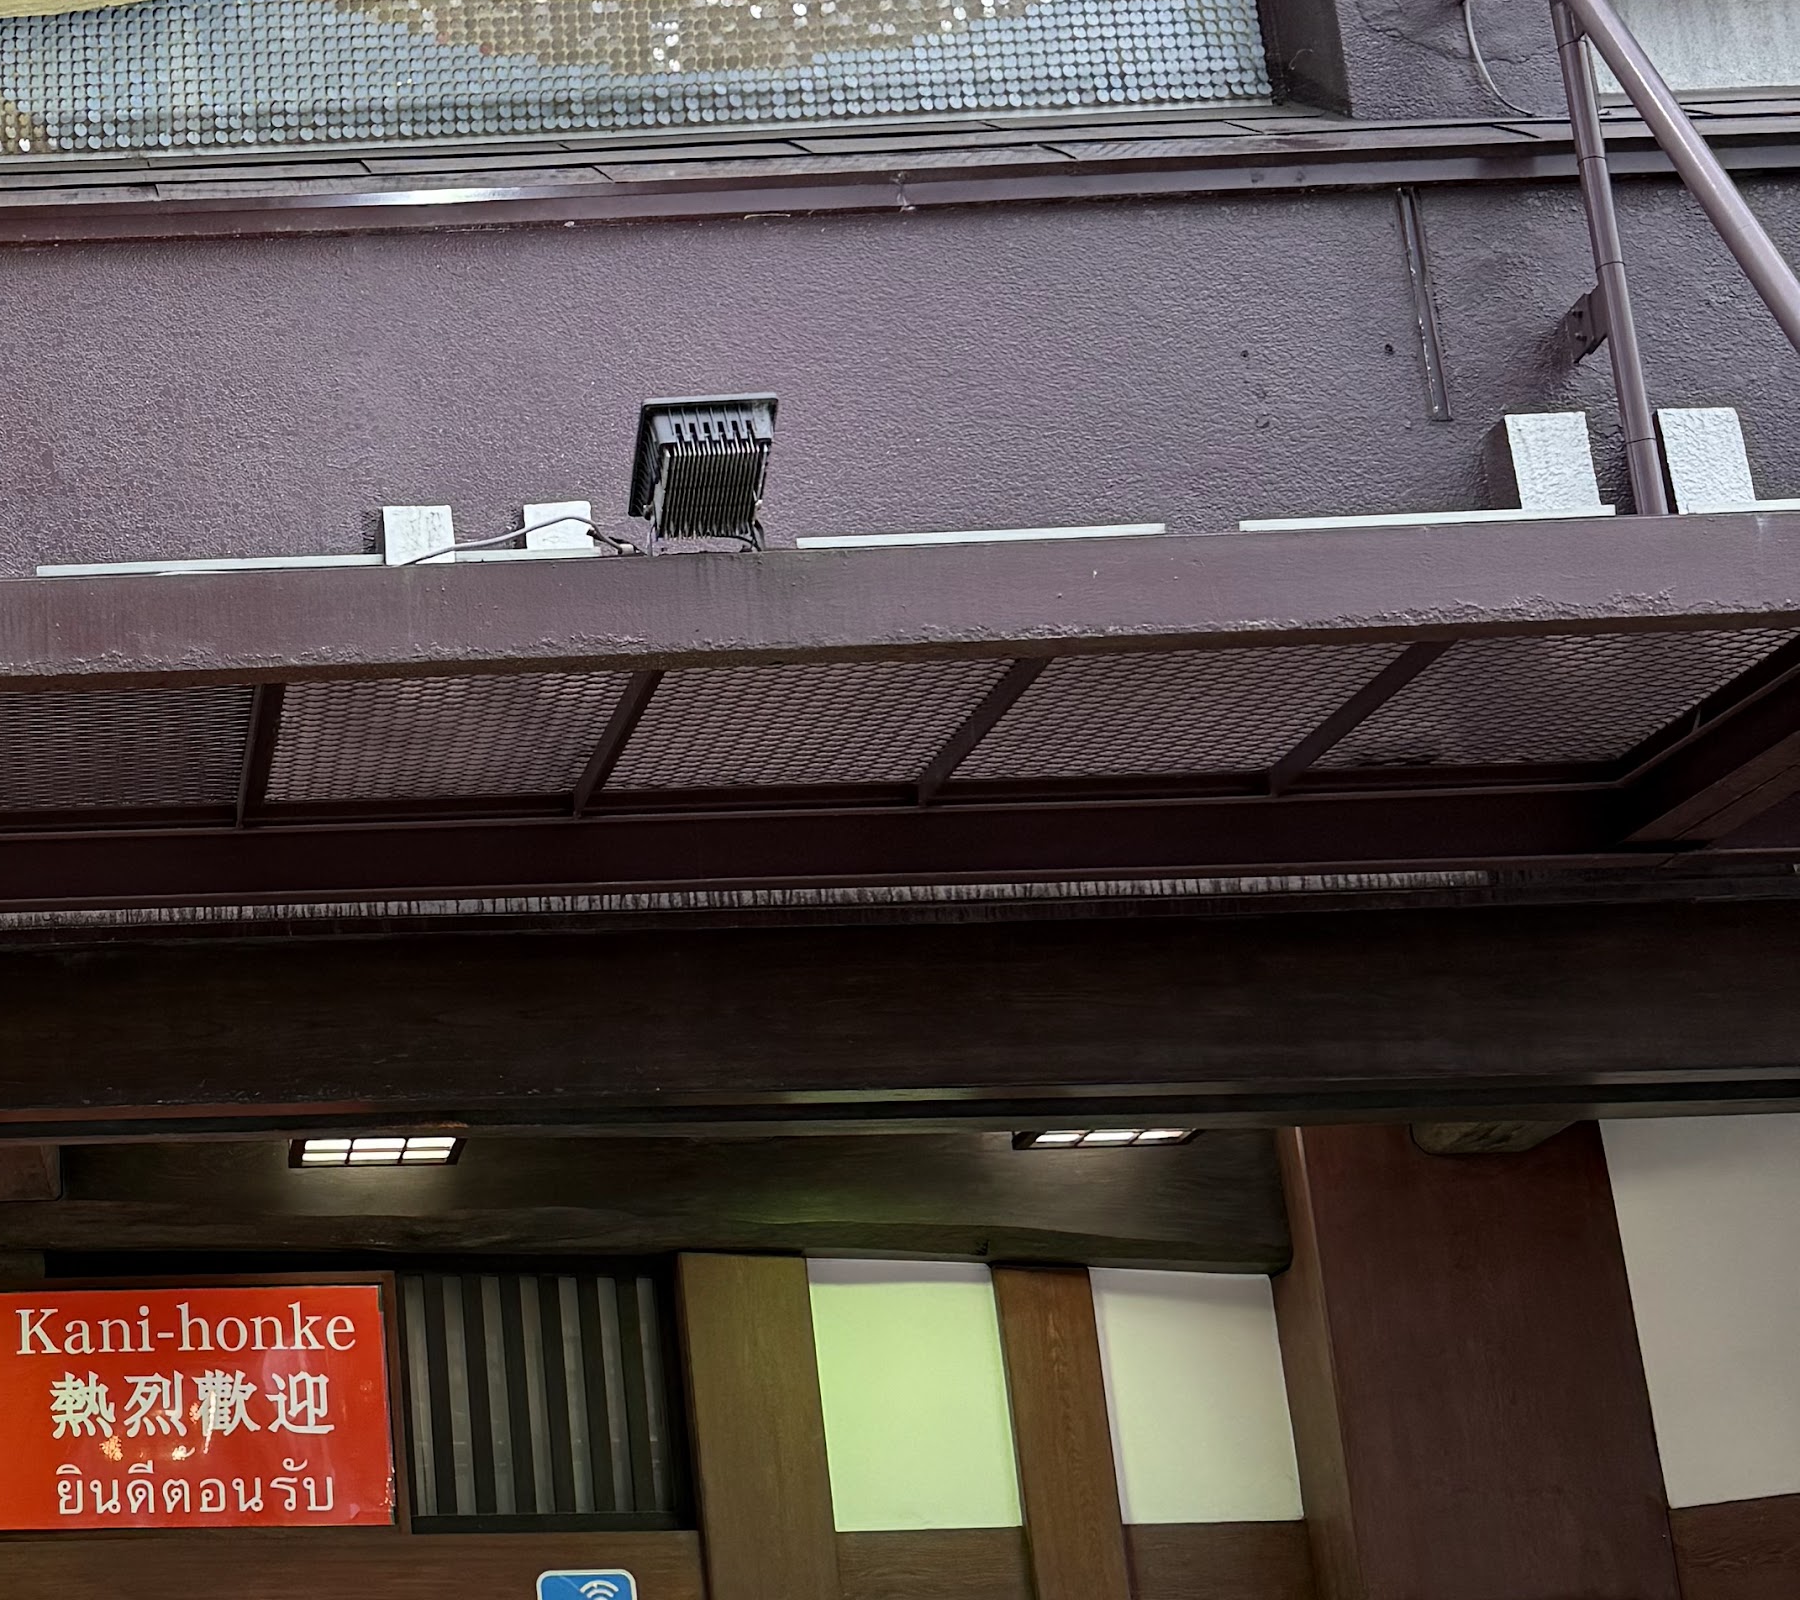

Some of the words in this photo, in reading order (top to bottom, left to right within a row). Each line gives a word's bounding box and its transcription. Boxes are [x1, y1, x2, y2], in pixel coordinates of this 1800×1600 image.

[15, 1302, 357, 1357] Kani-honke
[50, 1370, 334, 1440] 熱烈歡迎
